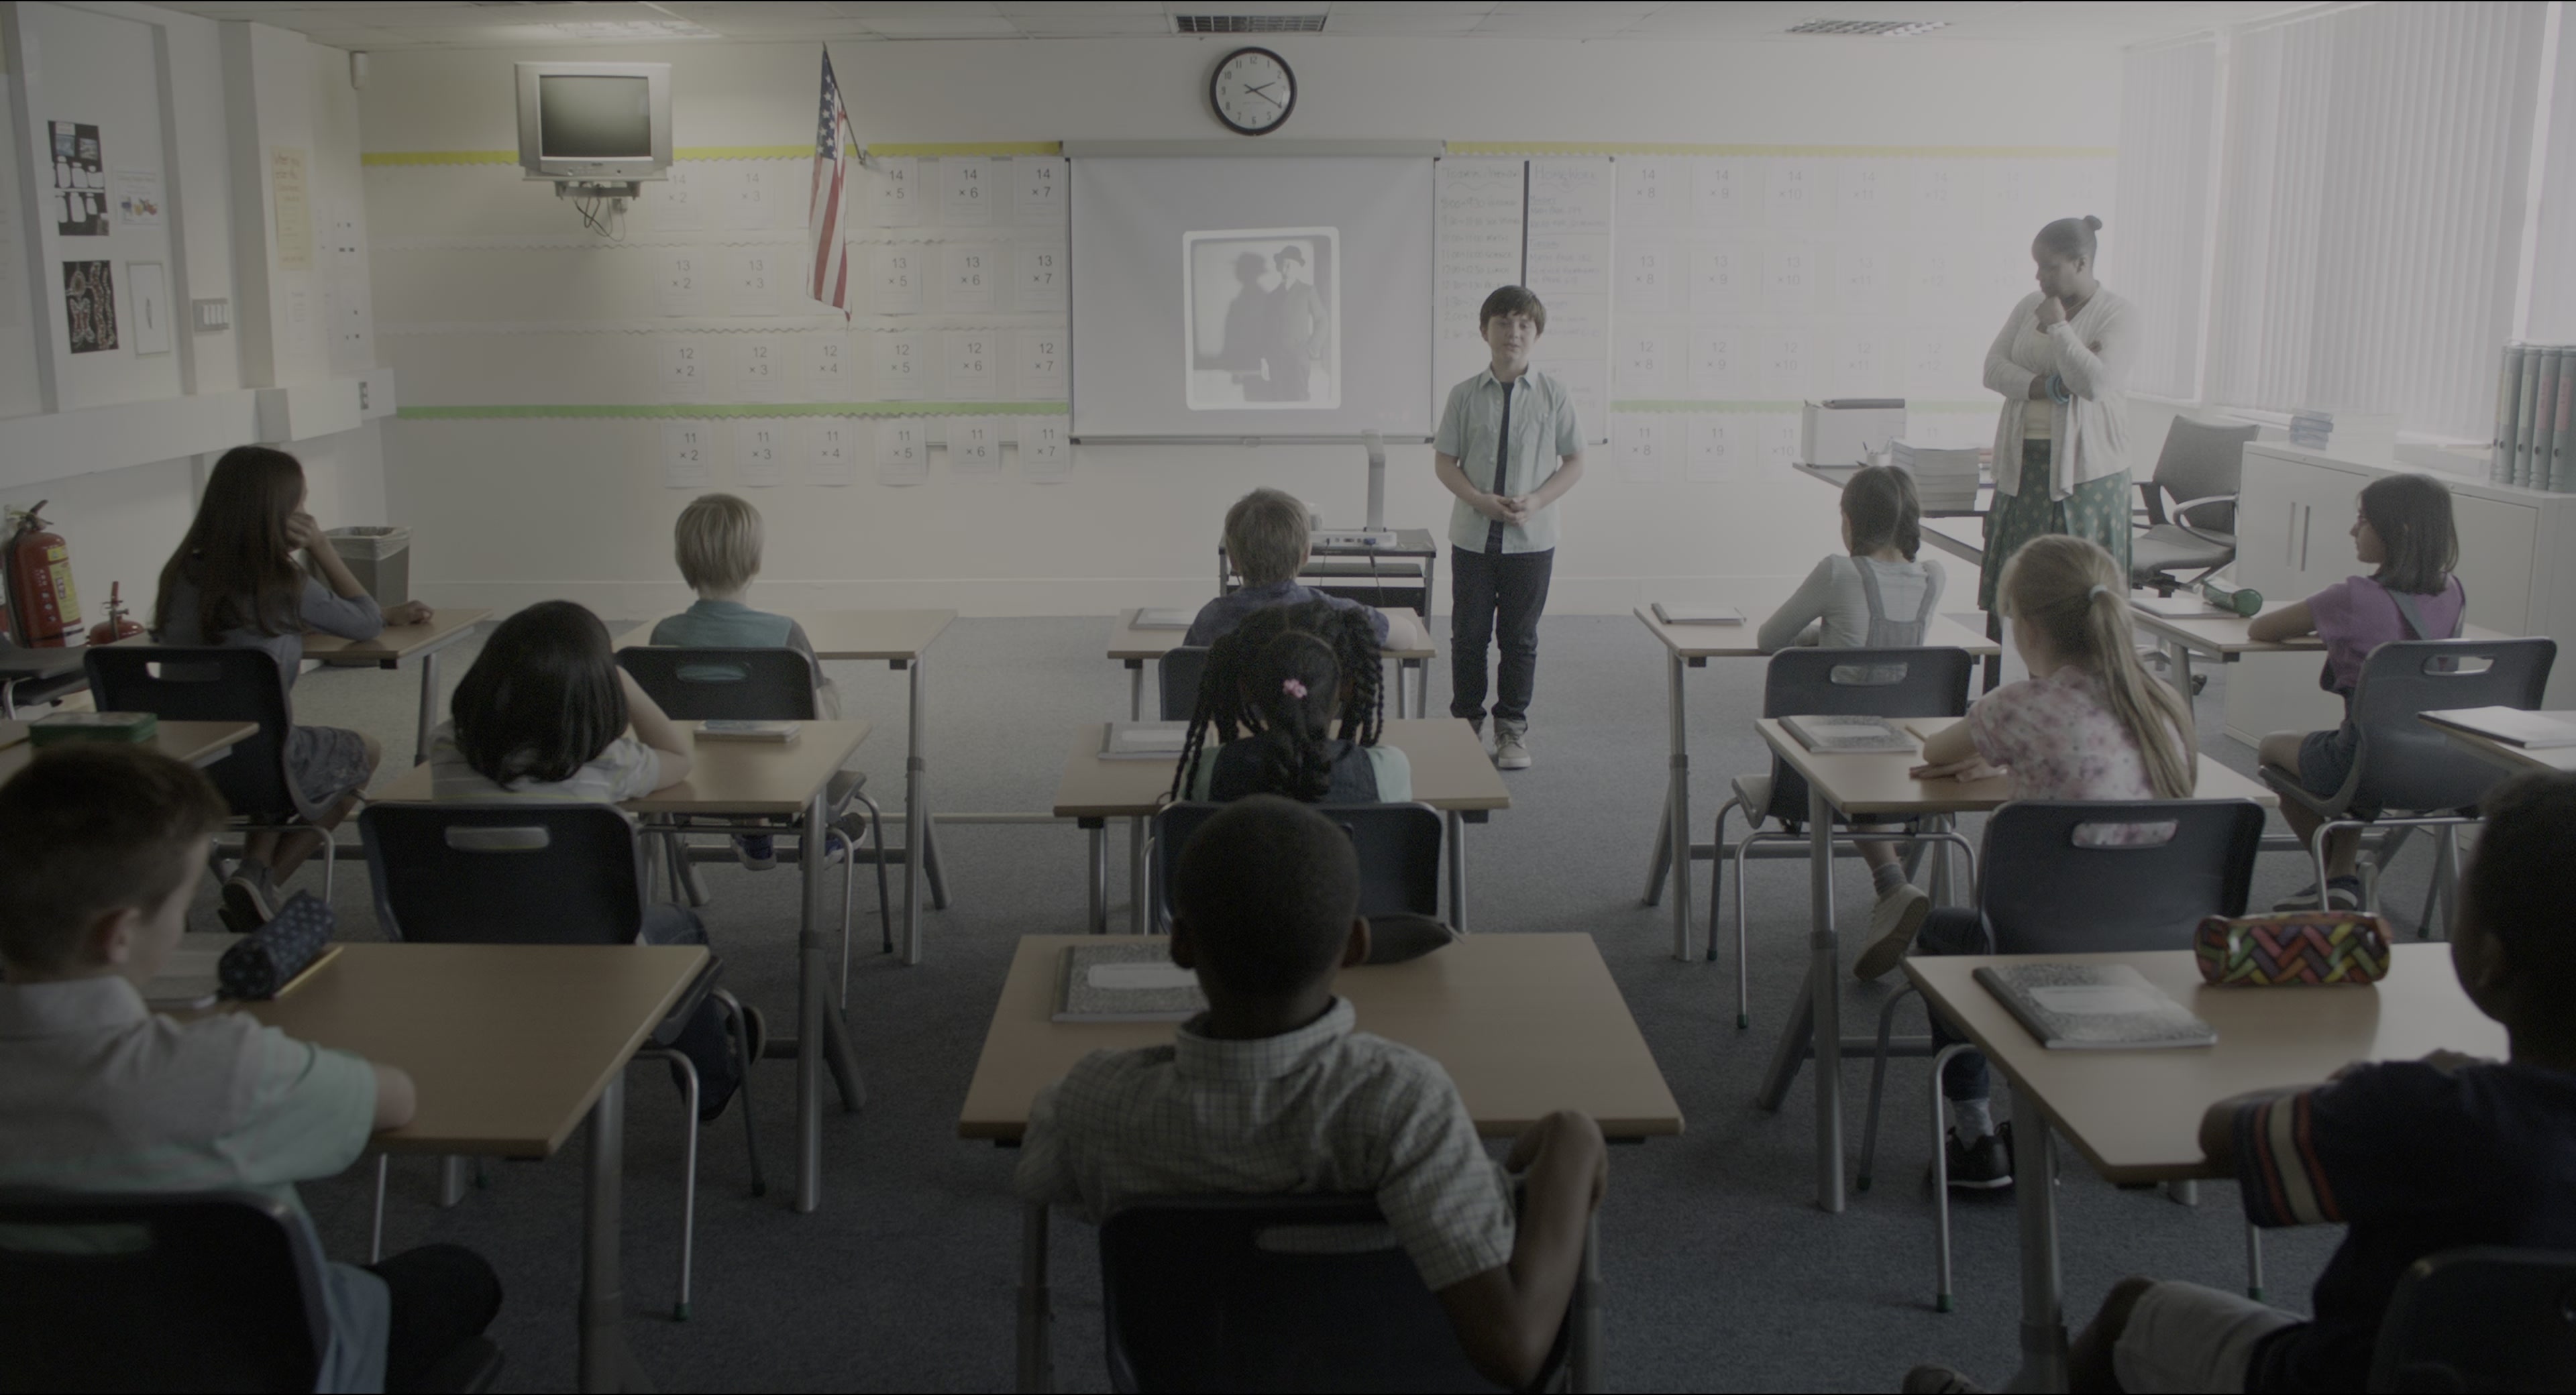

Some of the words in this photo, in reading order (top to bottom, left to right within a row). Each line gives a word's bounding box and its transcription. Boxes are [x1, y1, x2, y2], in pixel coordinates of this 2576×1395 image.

[1236, 60, 1242, 68] 11
[1250, 56, 1257, 64] 12
[1267, 60, 1270, 68] 1
[1224, 71, 1232, 80] 10
[1277, 71, 1281, 79] 2
[1222, 87, 1226, 95] 9
[1226, 102, 1230, 110] 8
[1238, 113, 1242, 121] 7
[1252, 116, 1256, 125] 6
[1267, 112, 1271, 121] 5
[672, 174, 686, 185] 14
[745, 172, 759, 183] 14
[889, 170, 904, 181] 14
[963, 168, 977, 180] 14
[1036, 168, 1051, 180] 14
[1642, 168, 1656, 180] 14
[1715, 169, 1729, 181] 14
[1788, 170, 1802, 182] 14
[1862, 171, 1876, 183] 14
[1934, 171, 1949, 183] 14
[680, 191, 688, 204] 2
[753, 189, 761, 203] 3
[896, 187, 905, 199] 5
[969, 186, 979, 199] 6
[1043, 186, 1051, 198] 7
[1647, 186, 1656, 199] 8
[1721, 187, 1729, 199] 9
[676, 259, 691, 272] 13
[749, 259, 764, 272] 13
[892, 257, 907, 269] 13
[965, 256, 980, 268] 13
[1037, 254, 1053, 267] 13
[1640, 255, 1655, 268] 13
[1713, 254, 1729, 268] 13
[1786, 255, 1801, 269] 13
[1858, 257, 1874, 269] 13
[1931, 257, 1945, 270] 13
[683, 277, 692, 290] 2
[756, 277, 765, 289] 3
[900, 275, 908, 287] 5
[972, 274, 981, 286] 6
[1044, 272, 1053, 284] 7
[1646, 273, 1655, 285] 8
[1719, 273, 1729, 285] 9
[679, 347, 694, 359] 12
[753, 346, 767, 358] 12
[823, 345, 838, 357] 12
[896, 343, 910, 356] 12
[967, 342, 982, 354] 12
[1039, 342, 1054, 355] 12
[1639, 341, 1654, 353] 12
[1712, 341, 1727, 353] 12
[1783, 341, 1799, 353] 12
[1857, 341, 1872, 355] 12
[1927, 343, 1942, 355] 12
[760, 364, 768, 376] 3
[830, 362, 838, 374] 4
[902, 361, 910, 374] 5
[974, 359, 983, 372] 6
[1046, 360, 1054, 372] 7
[1645, 358, 1654, 370] 8
[1717, 359, 1727, 371] 9
[686, 365, 694, 377] 2
[684, 432, 696, 443] 11
[757, 431, 769, 443] 11
[826, 431, 839, 441] 11
[898, 430, 910, 441] 11
[971, 429, 983, 440] 11
[1042, 429, 1054, 440] 11
[1639, 427, 1650, 439] 11
[1711, 427, 1723, 439] 11
[1781, 428, 1794, 440] 11
[1926, 426, 1938, 439] 11
[690, 449, 698, 461] 2
[763, 448, 772, 460] 3
[832, 448, 841, 459] 4
[904, 447, 913, 459] 5
[977, 445, 985, 458] 6
[1049, 445, 1056, 457] 7
[1643, 444, 1652, 457] 8
[1716, 445, 1725, 457] 9
